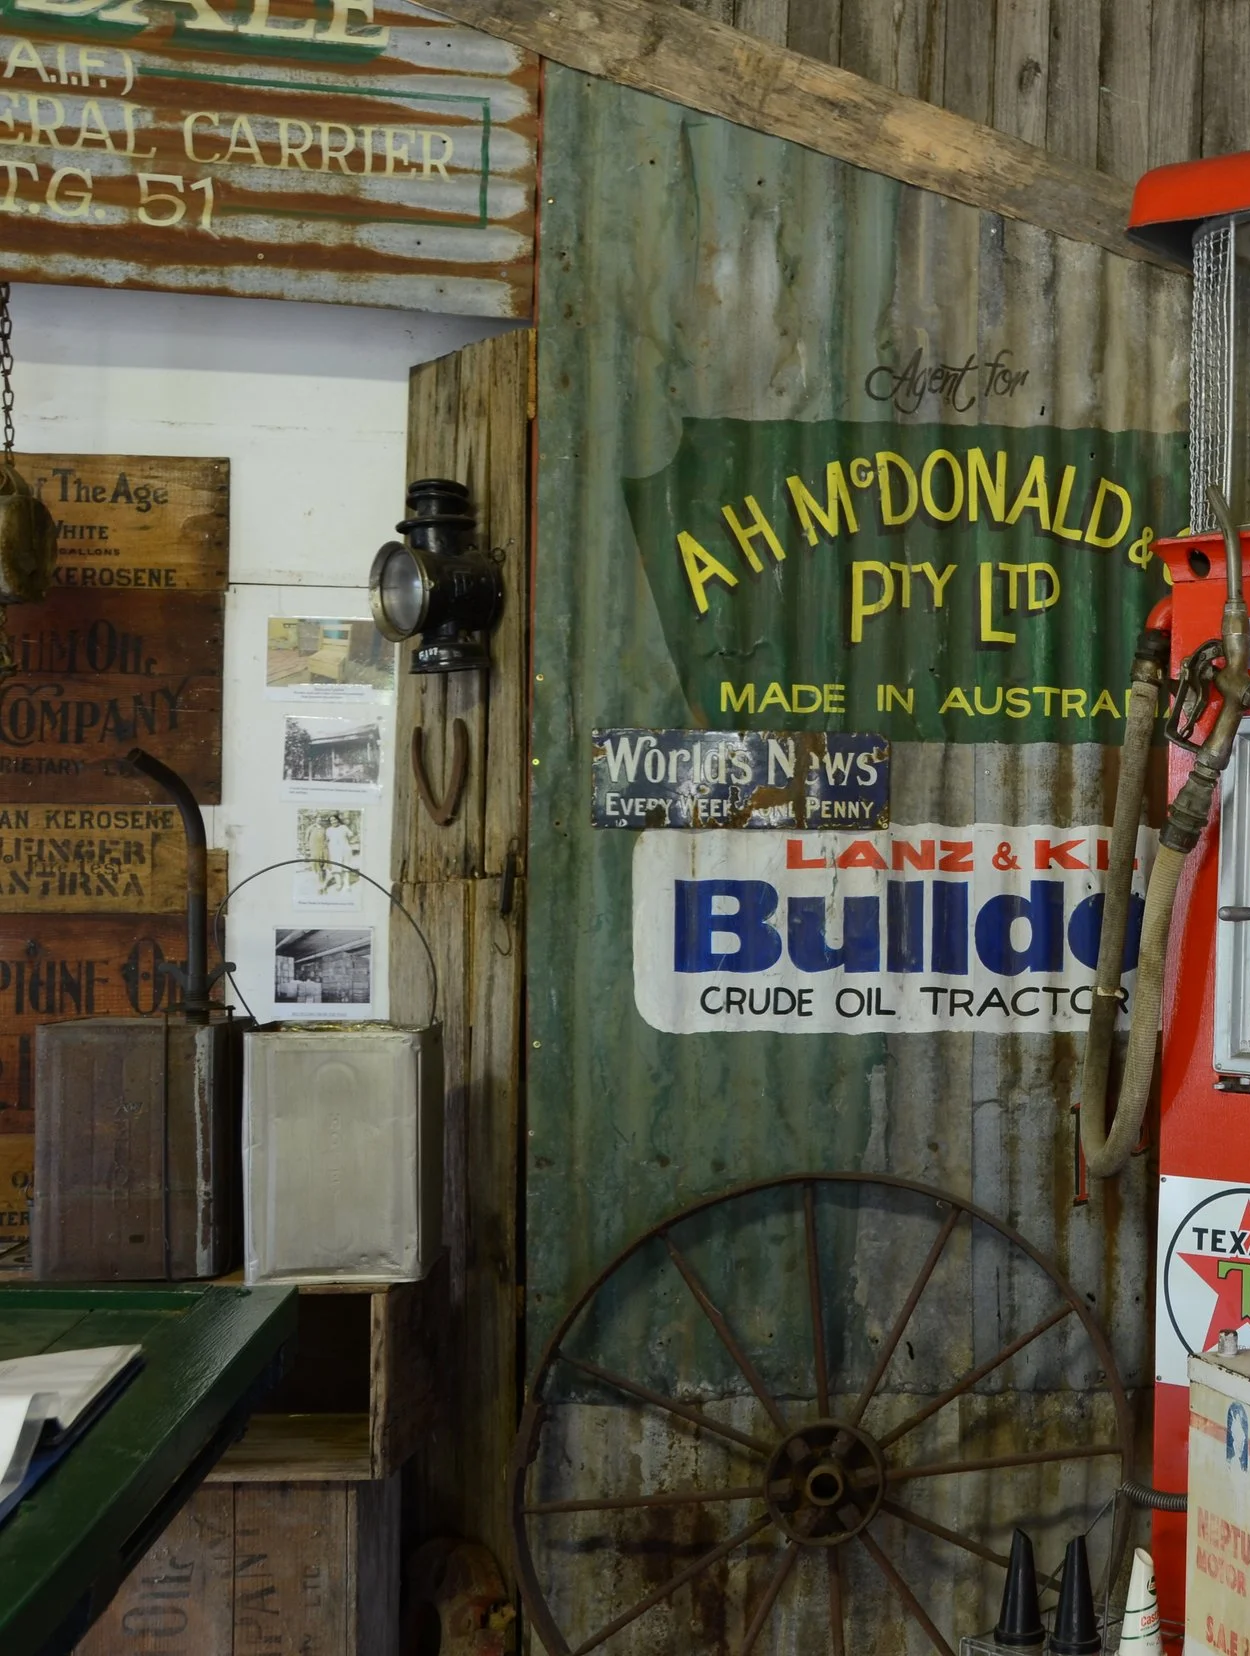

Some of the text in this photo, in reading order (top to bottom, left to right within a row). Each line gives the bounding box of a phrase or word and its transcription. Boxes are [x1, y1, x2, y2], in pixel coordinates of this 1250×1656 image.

[182, 112, 456, 183] CARRIER
[137, 173, 220, 238] 51
[865, 347, 1029, 414] Agent for
[52, 468, 107, 503] The
[109, 471, 170, 513] Age
[676, 530, 739, 614] A
[721, 495, 787, 573] H
[851, 560, 1060, 644] PTY LTD
[0, 675, 191, 748] COMPANY
[719, 681, 1170, 720] MADE IN AUSTRA
[45, 810, 175, 830] KEROSENE
[806, 797, 875, 819] PENNY
[787, 838, 974, 872] LANZ
[991, 842, 1023, 872] &
[700, 985, 814, 1017] CRUDE
[835, 986, 896, 1017] OIL
[1196, 1545, 1247, 1598] MOTOR
